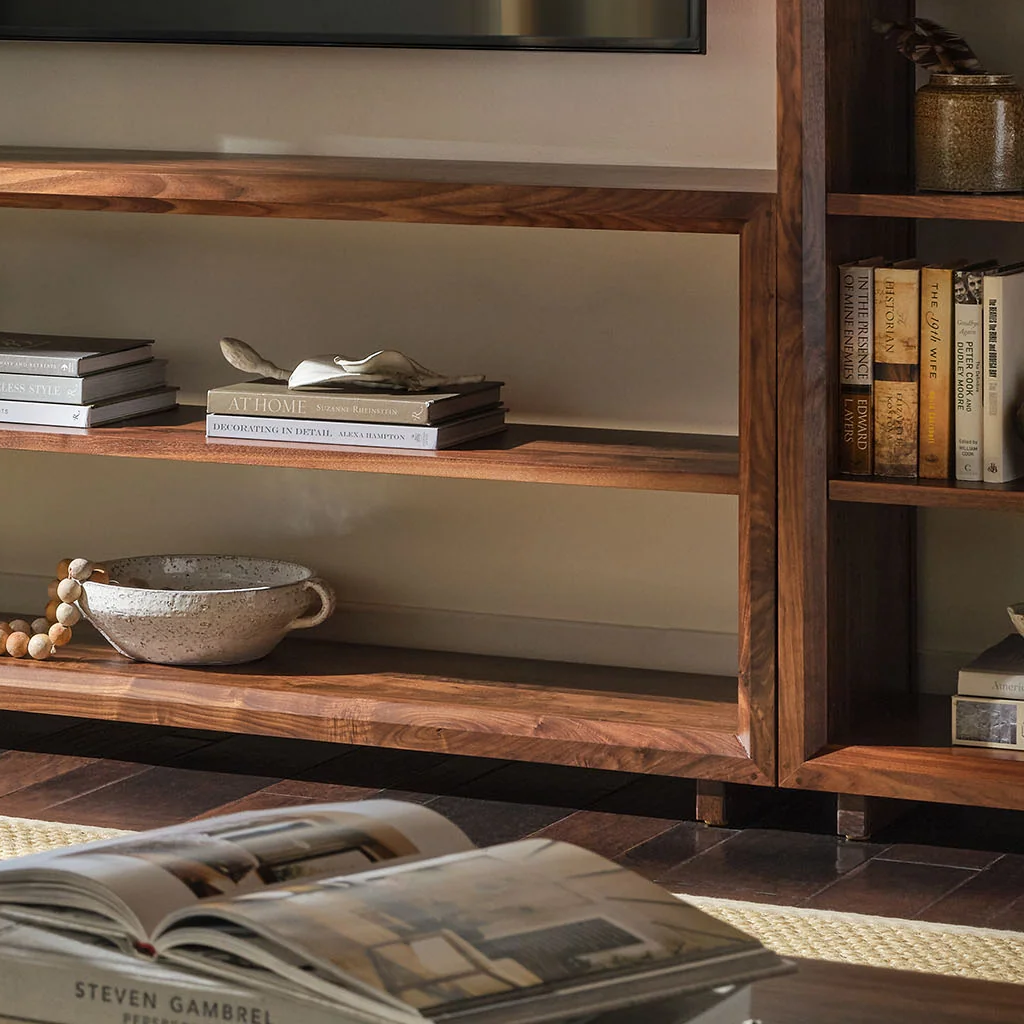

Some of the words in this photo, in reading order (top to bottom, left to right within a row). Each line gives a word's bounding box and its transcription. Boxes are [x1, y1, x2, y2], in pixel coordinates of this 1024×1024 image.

[844, 274, 854, 291] OF
[858, 276, 869, 290] IN
[930, 283, 938, 308] THE
[844, 294, 854, 326] MINE
[858, 293, 869, 318] THE
[885, 281, 895, 353] HISTORIAN
[926, 311, 941, 342] 19th
[844, 330, 854, 380] ENEMIES
[858, 321, 869, 380] PRESENCE
[929, 348, 937, 379] WIFE
[966, 341, 974, 370] PETER
[988, 352, 998, 368] BODEGA
[966, 372, 974, 396] COOK
[988, 370, 998, 378] BAY
[28, 383, 62, 396] STYLE
[228, 396, 254, 412] AT
[254, 397, 307, 414] HOME
[213, 422, 280, 434] DECORATING
[282, 426, 294, 434] IN
[295, 428, 333, 438] DETAIL
[338, 430, 364, 439] ALEXA
[366, 432, 406, 441] HAMPTON
[844, 408, 854, 443] AYERS
[857, 399, 868, 450] EDWARD
[76, 981, 158, 1009] STEVEN
[170, 994, 275, 1024] GAMBREL
